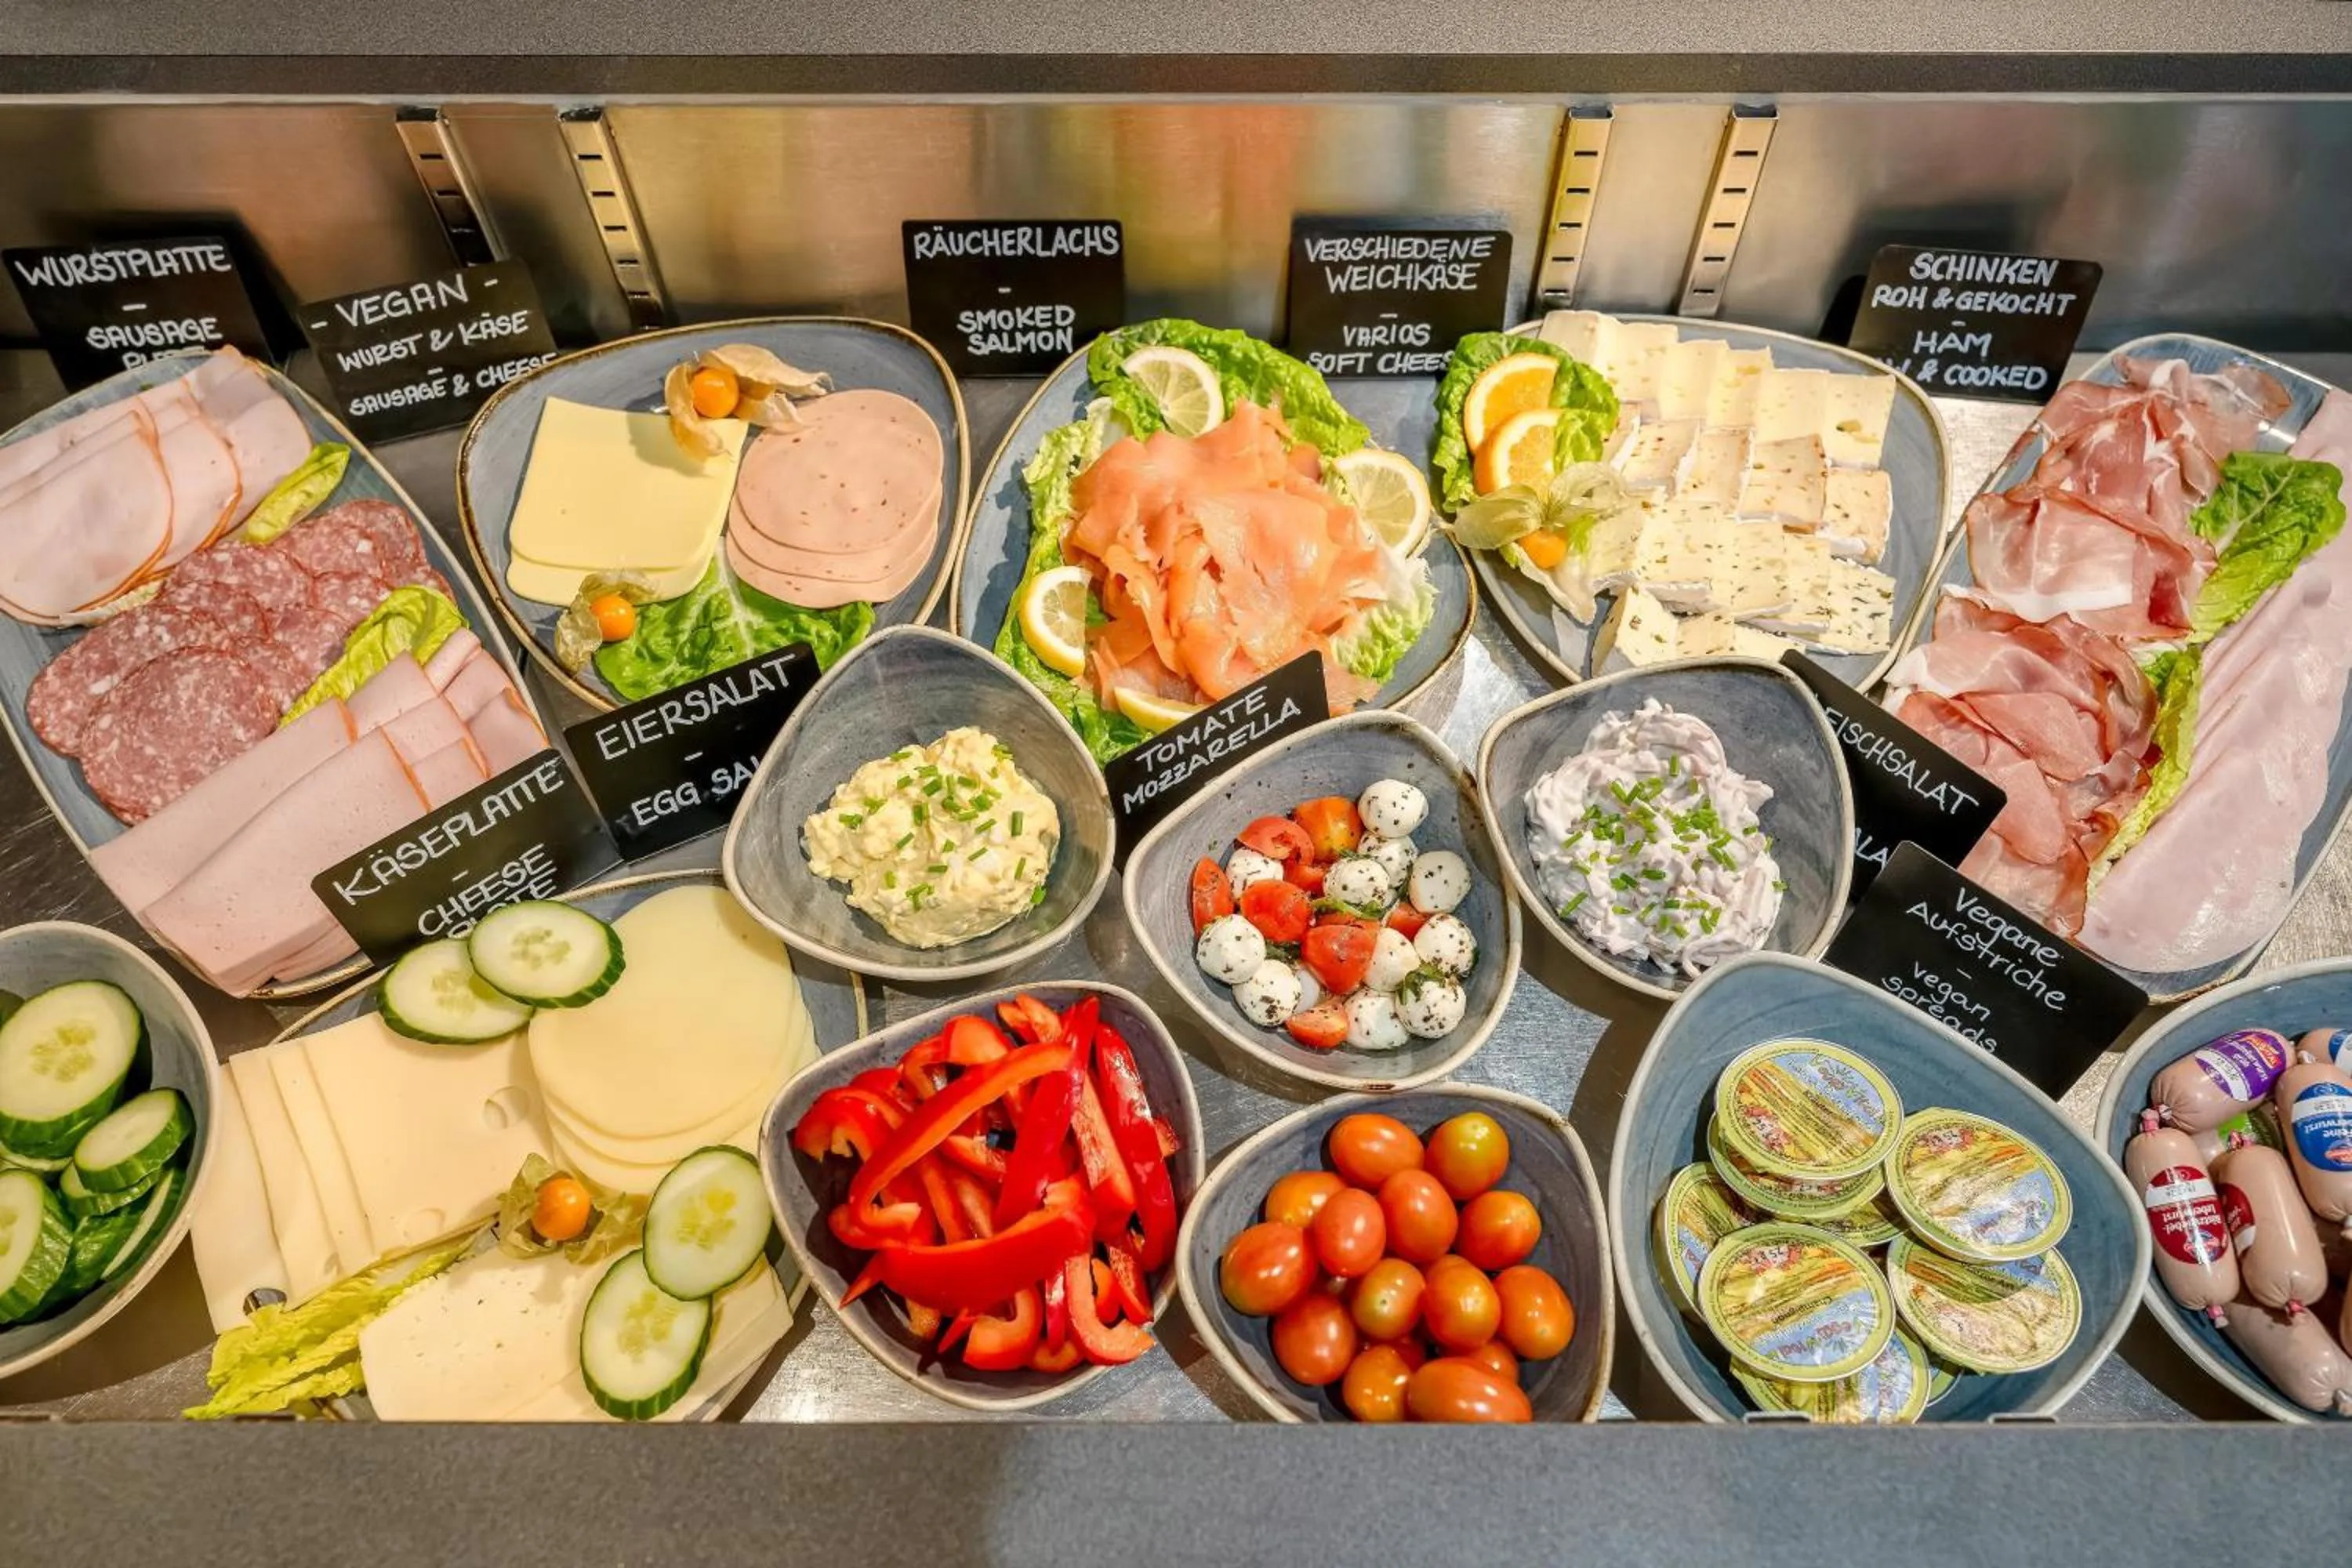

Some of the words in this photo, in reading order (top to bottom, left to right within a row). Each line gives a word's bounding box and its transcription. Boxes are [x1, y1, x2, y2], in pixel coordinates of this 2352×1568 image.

[913, 225, 1120, 260] RÄUCHERLACHS
[1305, 235, 1496, 263] VERSCHIEDENE
[15, 245, 232, 287] WURSTPLATTE
[1324, 258, 1482, 293] WEICHKÄSE
[1909, 252, 2060, 287] SCHINKEN
[336, 273, 469, 327] VEGAN
[956, 304, 1076, 334] SMOKED
[1871, 284, 1928, 310] ROH
[1932, 287, 1954, 309] &
[1955, 290, 2077, 316] GEKOCHT
[86, 318, 223, 349] SAUSAGE
[337, 333, 424, 372] WURST
[430, 328, 453, 351] &
[459, 310, 529, 345] KÄSE
[967, 326, 1073, 355] SALMON
[1913, 330, 1993, 358] HAM
[1307, 352, 1372, 373] SOFT
[1377, 350, 1455, 373] CHEES
[1944, 363, 2049, 390] COOKED
[349, 378, 448, 416] SAUSAGE
[452, 374, 470, 397] &
[595, 653, 796, 760] EIERSALAT
[1135, 685, 1268, 772] TOMATE
[1123, 697, 1301, 815] MOZZARELLA
[630, 781, 702, 826] EGG
[332, 756, 564, 906] KÄSEPLATTE
[417, 843, 553, 937] CHEESE
[1955, 887, 2061, 967] Vegane
[1906, 901, 2067, 1011] Aufstriche
[1772, 1295, 1832, 1324] Champignon
